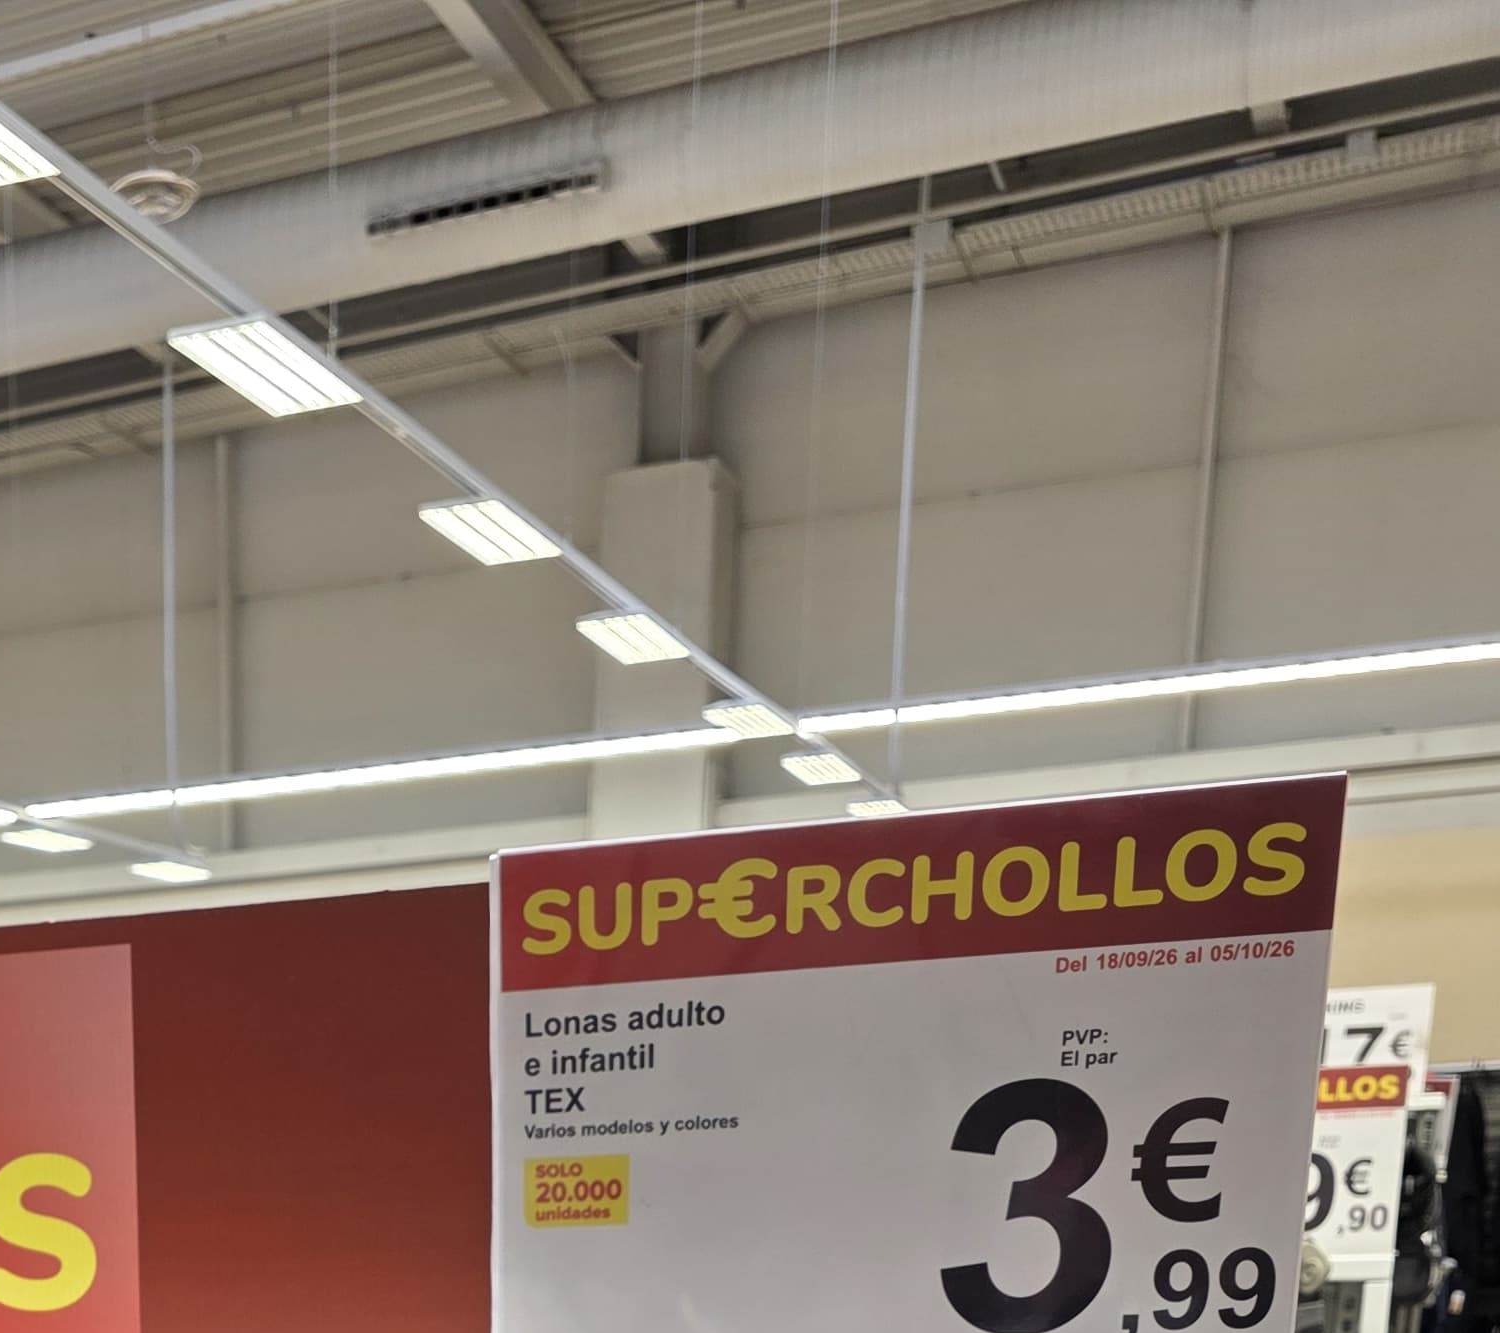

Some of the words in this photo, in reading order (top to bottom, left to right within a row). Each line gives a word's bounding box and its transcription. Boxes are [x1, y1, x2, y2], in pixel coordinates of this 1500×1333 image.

[1055, 955, 1088, 975] Del
[1095, 948, 1178, 973] 18/09/26
[1185, 945, 1203, 965] al
[1210, 938, 1295, 964] 05/10/26
[525, 1010, 617, 1038] Lonas
[627, 1000, 725, 1031] adulto
[1061, 1029, 1110, 1046] PVP:
[524, 1057, 541, 1076] e
[551, 1043, 655, 1075] infantil
[1060, 1051, 1079, 1067] El
[1085, 1051, 1118, 1069] par
[524, 1086, 585, 1115] TEX
[524, 1122, 576, 1139] Varios
[581, 1118, 654, 1137] modelos
[660, 1119, 670, 1136] y
[675, 1115, 739, 1132] colores
[535, 1163, 583, 1179] SOLO
[535, 1179, 622, 1203] 20.000
[535, 1204, 611, 1222] unidades
